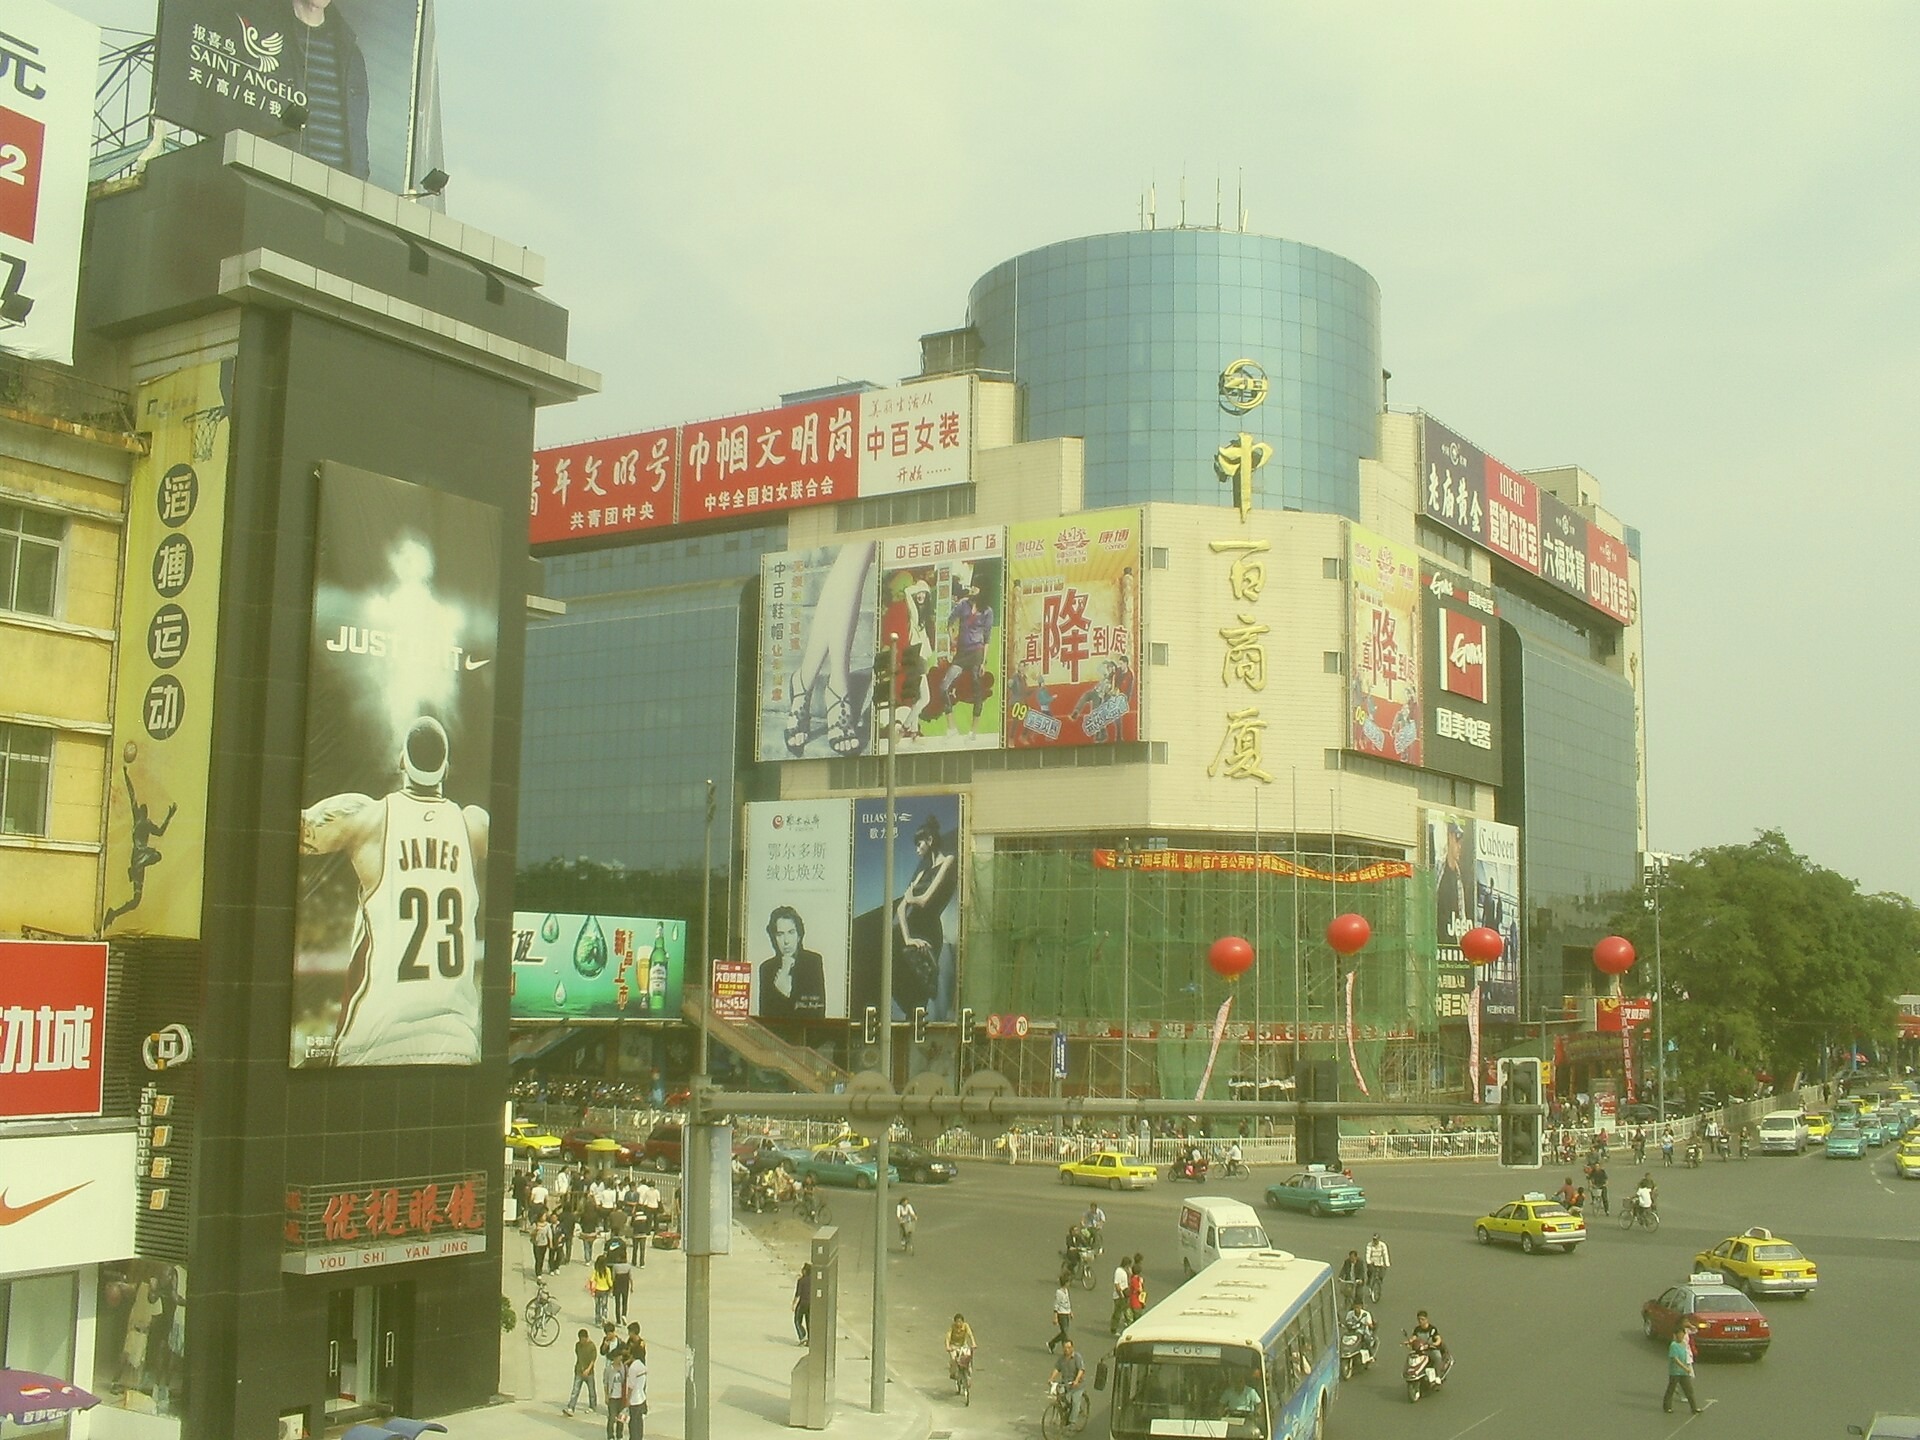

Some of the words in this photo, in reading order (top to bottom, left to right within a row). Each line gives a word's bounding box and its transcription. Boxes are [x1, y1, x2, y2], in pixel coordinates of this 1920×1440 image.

[192, 23, 237, 56] 报喜鸟
[190, 44, 241, 78] SAINT
[243, 69, 308, 106] ANGELO
[688, 406, 853, 482] 巾帼文明岗
[867, 411, 960, 461] 中百女装
[704, 475, 834, 513] 中华全国妇女联合会
[570, 501, 654, 531] 共青团中央
[895, 534, 997, 560] 中百运动休闲广场
[148, 473, 193, 731] 滔搏运动
[1207, 432, 1275, 784] 中百商厦
[1436, 706, 1491, 750] 国美电器
[398, 838, 460, 874] JAMES
[768, 841, 826, 860] 鄂尔多斯
[766, 863, 825, 881] 绒光焕发
[397, 886, 465, 983] 23
[319, 1256, 346, 1269] YOU
[363, 1249, 385, 1264] SHI
[405, 1245, 430, 1259] YAN
[440, 1240, 469, 1254] JING
